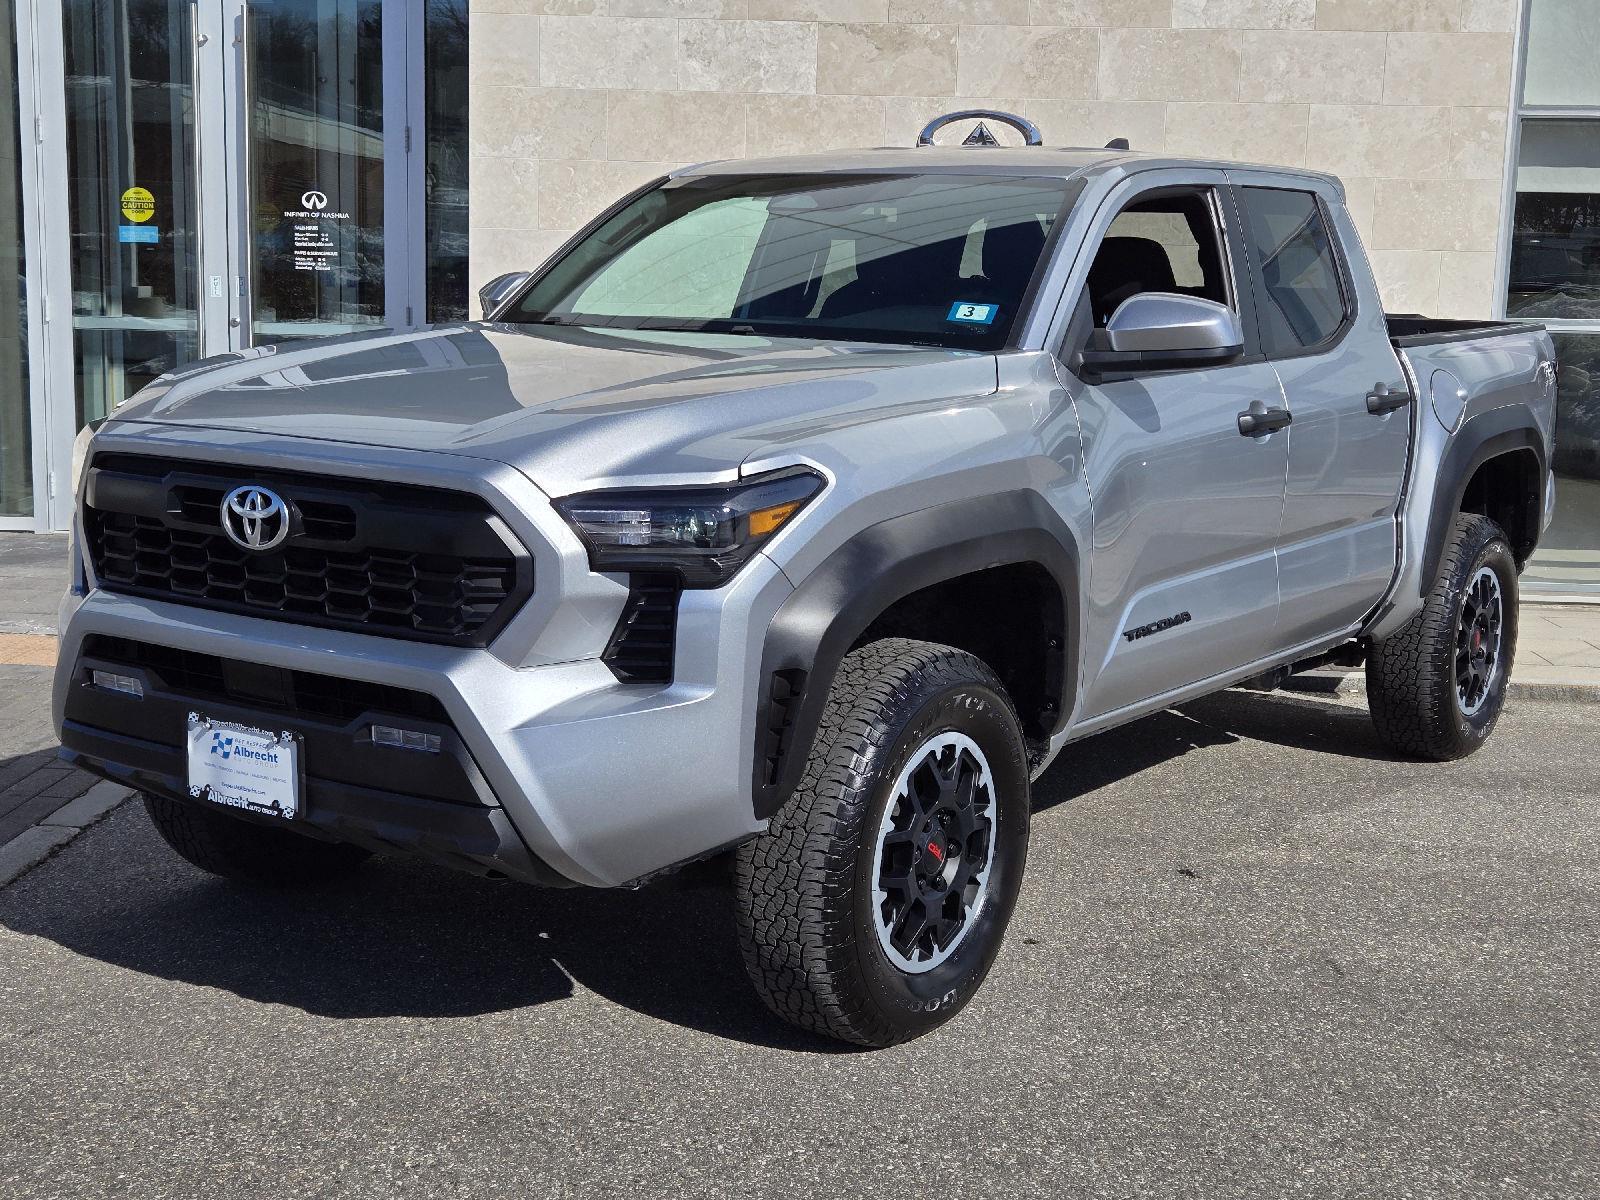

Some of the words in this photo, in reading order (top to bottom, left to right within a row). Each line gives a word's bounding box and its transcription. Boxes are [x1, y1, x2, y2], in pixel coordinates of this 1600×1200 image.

[963, 306, 975, 317] 3
[1123, 611, 1192, 642] TACOMA
[234, 745, 278, 763] Albrecht
[207, 790, 248, 809] Albrecht
